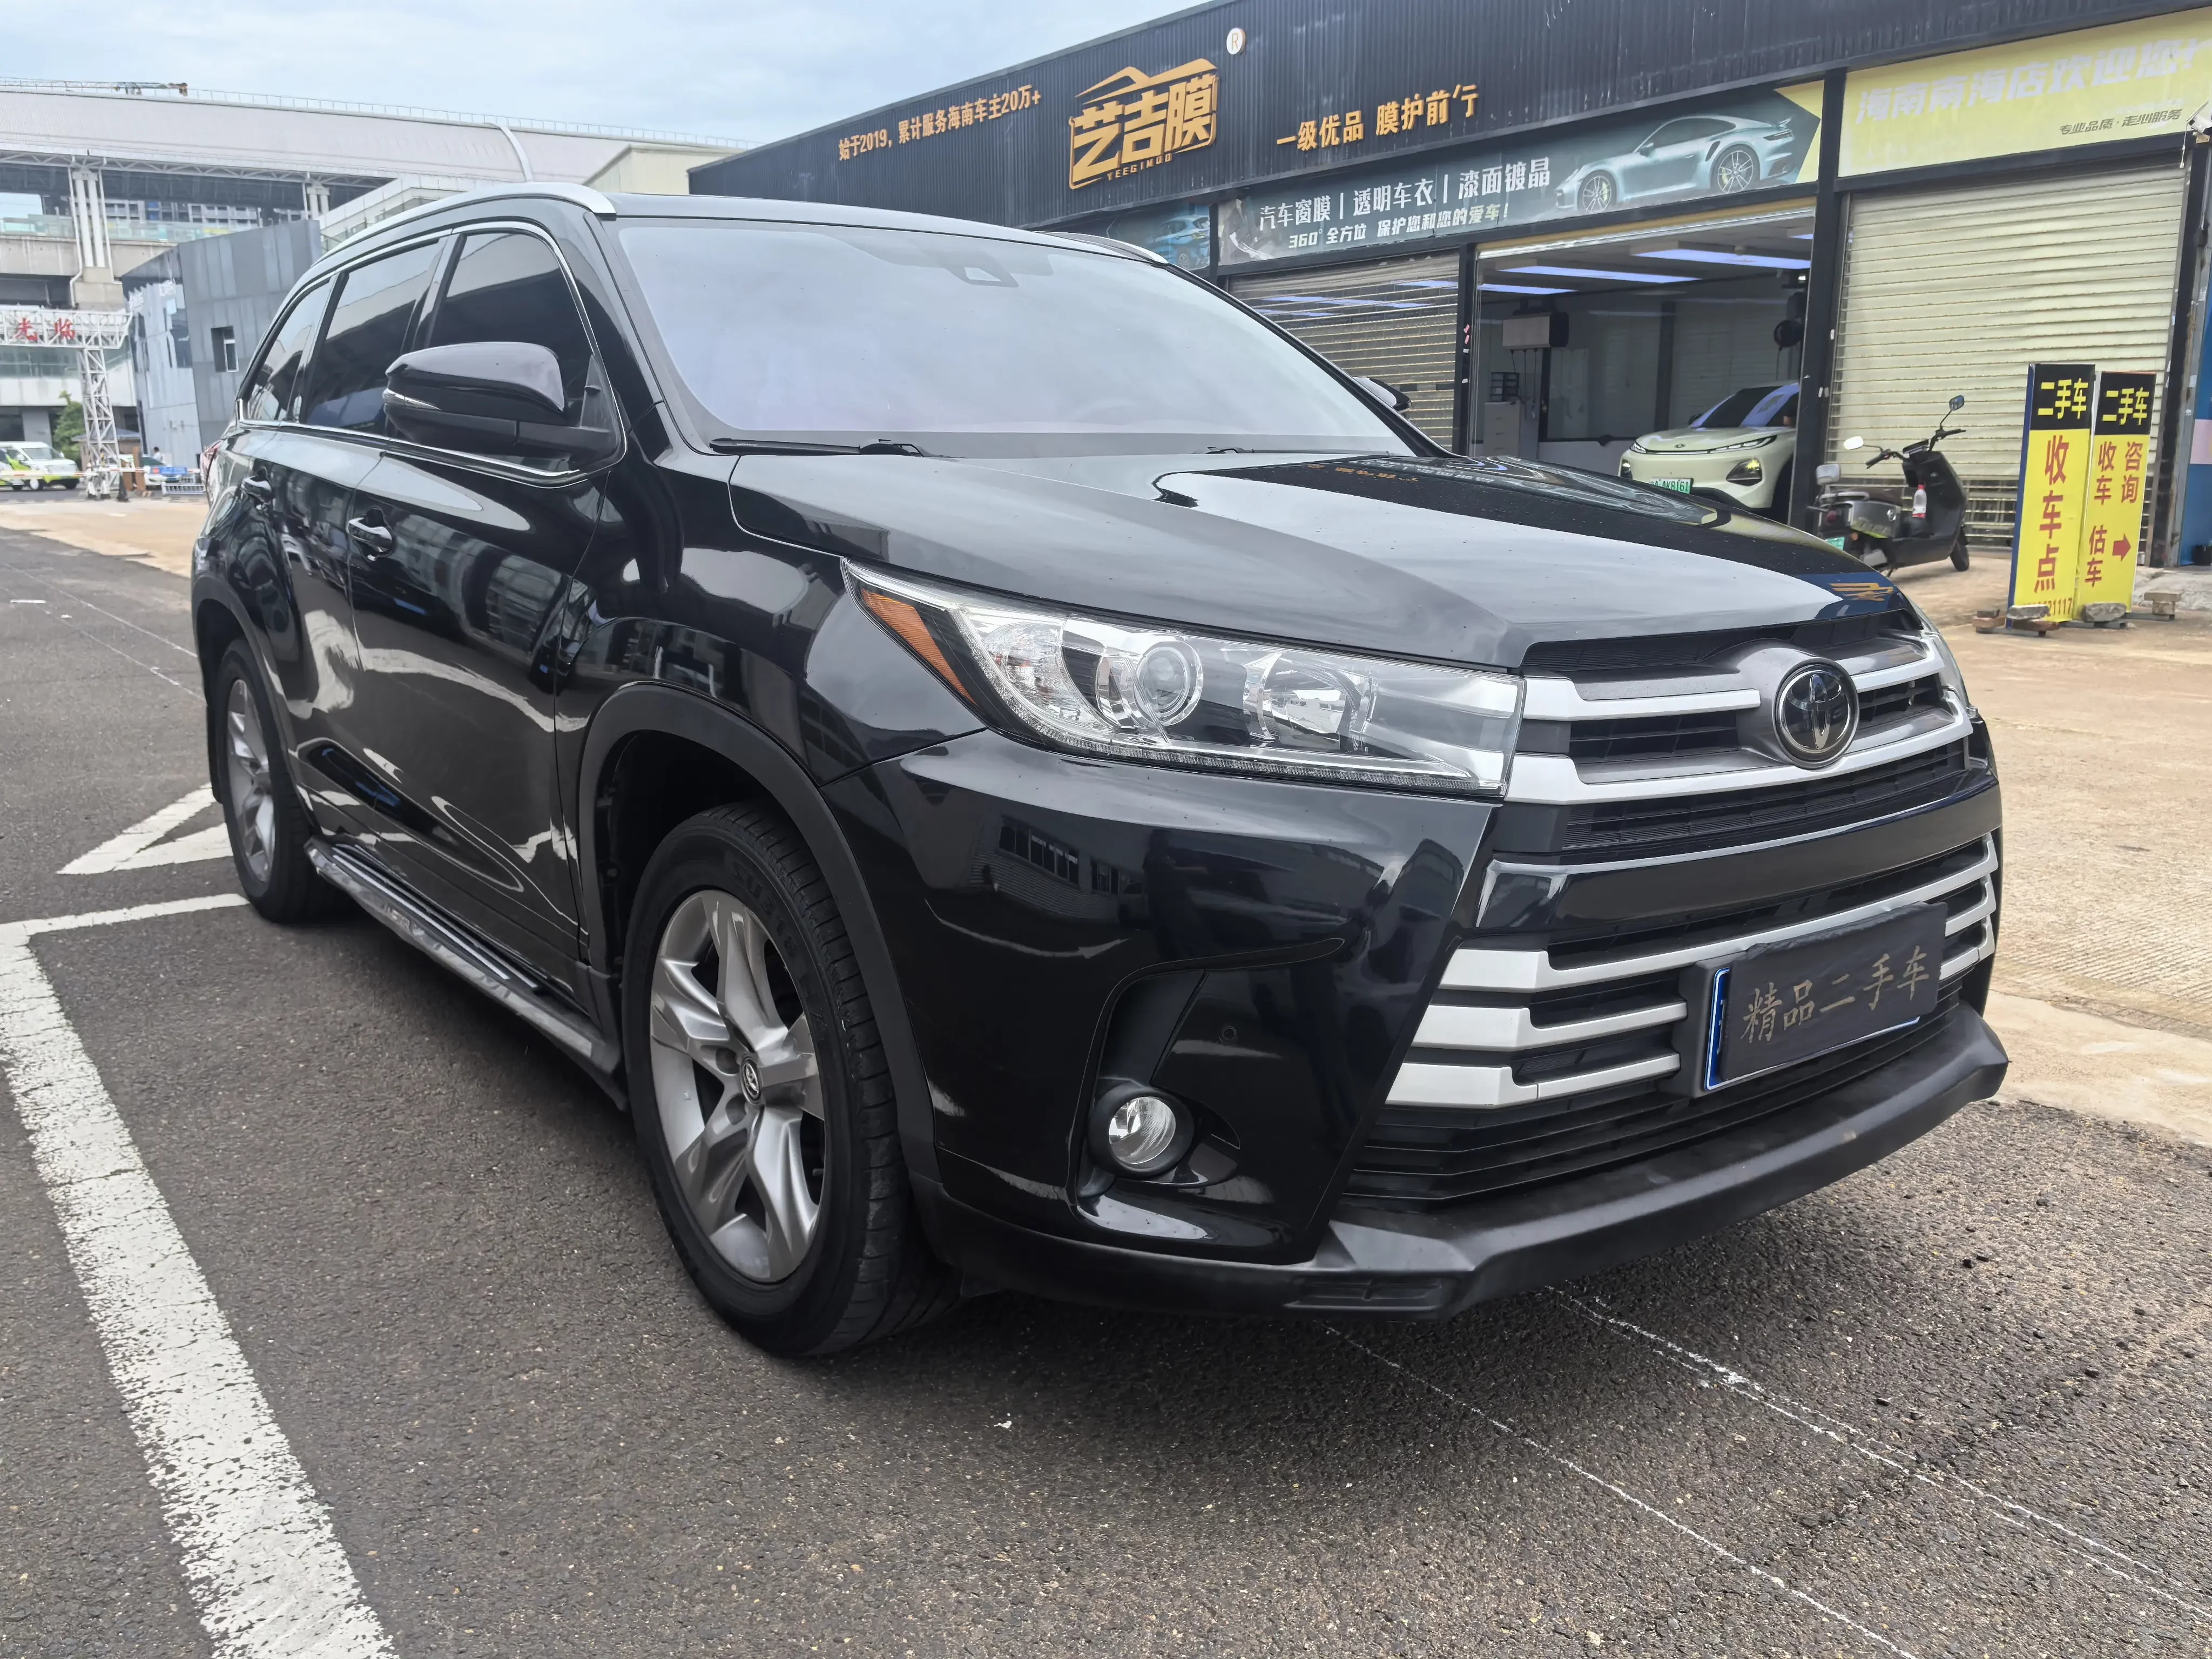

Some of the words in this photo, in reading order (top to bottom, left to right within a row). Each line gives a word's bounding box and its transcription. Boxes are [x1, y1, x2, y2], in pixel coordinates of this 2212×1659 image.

[1276, 110, 1364, 151] 一级优品
[1375, 84, 1479, 137] 膜护前行
[1260, 195, 1331, 231] 汽车窗膜
[1353, 178, 1434, 216] 透明车衣
[1459, 157, 1550, 199] 漆面镀晶
[2037, 378, 2088, 420] 二手车
[2102, 387, 2149, 426] 二手车
[2121, 441, 2143, 503] 咨询
[2034, 435, 2069, 594] 收车点
[1741, 945, 1930, 1043] 精品二手车
